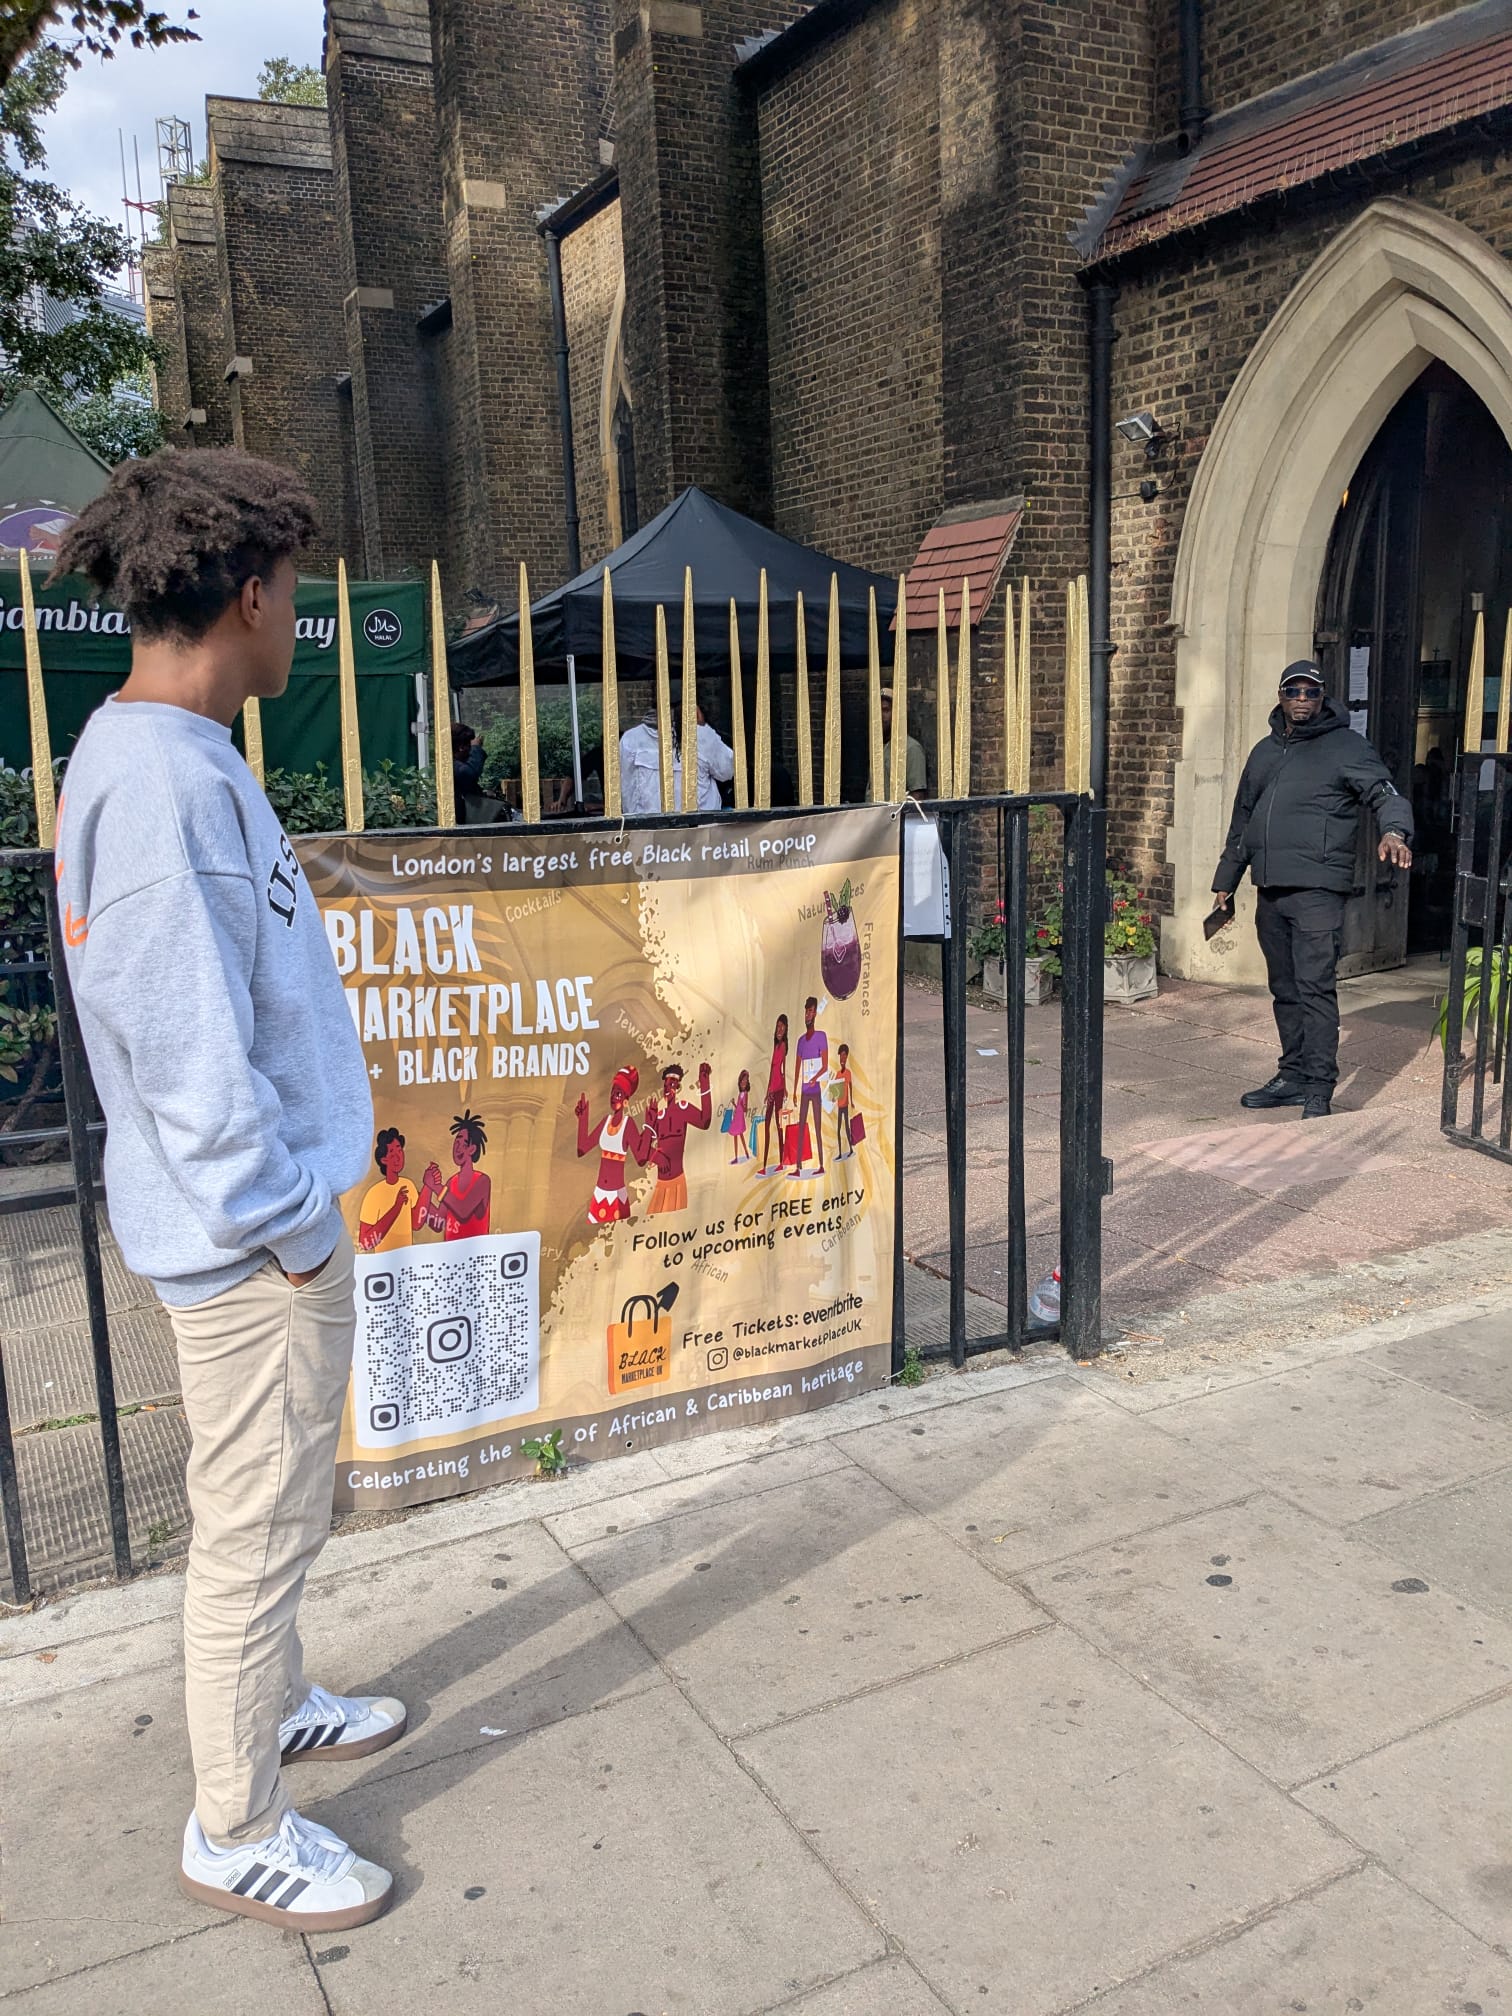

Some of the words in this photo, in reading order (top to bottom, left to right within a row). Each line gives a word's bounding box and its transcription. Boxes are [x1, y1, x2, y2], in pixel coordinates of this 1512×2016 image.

[0, 597, 131, 634] ambia
[374, 633, 393, 641] HALAL
[392, 853, 492, 877] London's
[503, 850, 579, 879] largest
[589, 848, 633, 872] free
[642, 843, 691, 865] Black
[701, 838, 750, 861] retail
[747, 855, 774, 870] Rum
[779, 853, 816, 869] Punch
[505, 889, 562, 923] Cocktails
[324, 904, 482, 976] BLACK
[862, 922, 874, 1017] Fragrances
[398, 1046, 479, 1086] BLACK
[492, 1041, 591, 1079] BRANDS
[417, 1206, 461, 1234] Prints
[632, 1228, 698, 1251] Follow
[705, 1220, 725, 1236] us
[734, 1212, 764, 1232] for
[770, 1197, 812, 1223] FREE
[821, 1188, 865, 1212] entry
[821, 1212, 862, 1253] Caribbean
[663, 1250, 684, 1268] to
[692, 1229, 776, 1260] upcoming
[783, 1215, 843, 1239] events
[690, 1258, 729, 1284] African
[682, 1328, 724, 1349] Free
[732, 1313, 799, 1338] Tickets:
[802, 1292, 863, 1326] eventbrite
[618, 1345, 667, 1370] BLACK
[348, 1454, 470, 1490] Celebrating
[479, 1442, 513, 1465] the
[574, 1422, 599, 1443] of
[607, 1405, 677, 1438] African
[686, 1398, 699, 1416] &
[707, 1382, 793, 1411] Caribbean
[801, 1358, 864, 1394] heritage
